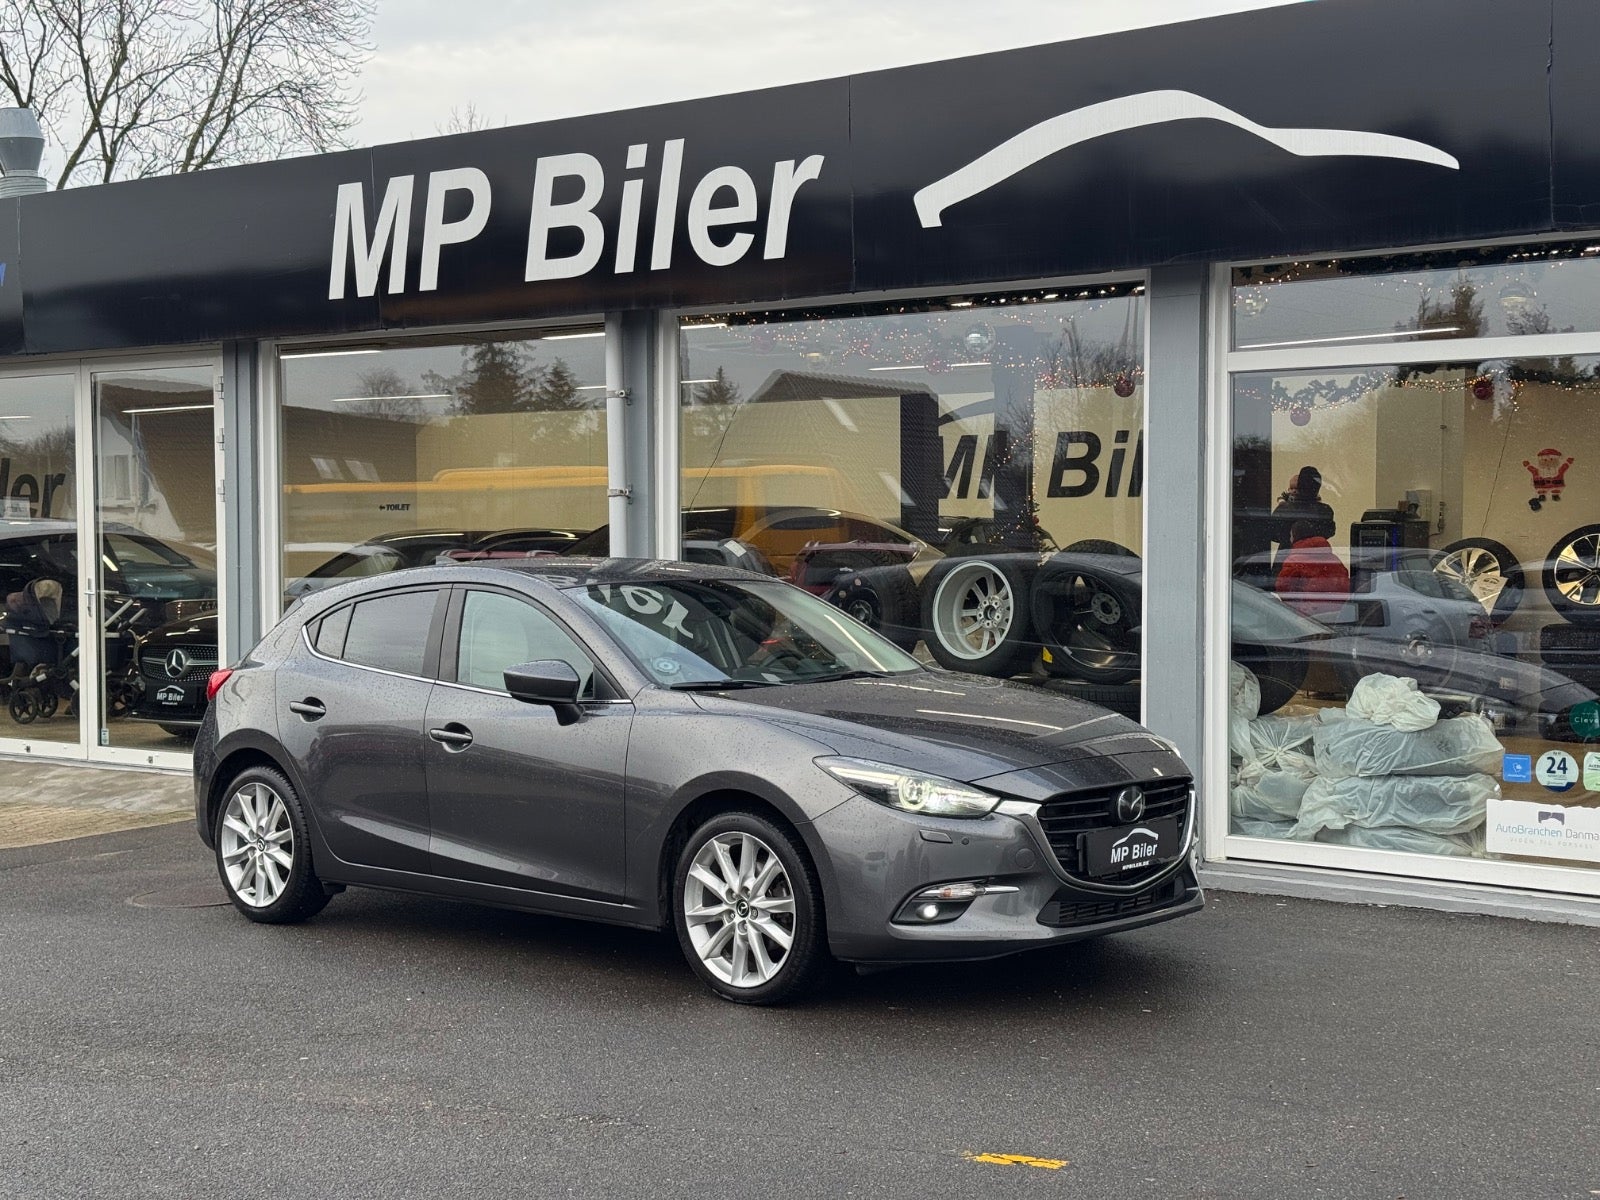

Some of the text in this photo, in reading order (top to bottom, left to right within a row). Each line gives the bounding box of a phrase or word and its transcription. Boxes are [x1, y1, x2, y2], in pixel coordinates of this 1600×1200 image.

[328, 138, 825, 300] MP Biler
[386, 503, 411, 511] TOILET
[156, 692, 184, 701] MP Biler
[1546, 757, 1568, 774] 24
[1496, 823, 1599, 841] AutoBranchen Danma
[1110, 843, 1158, 864] MP Biler
